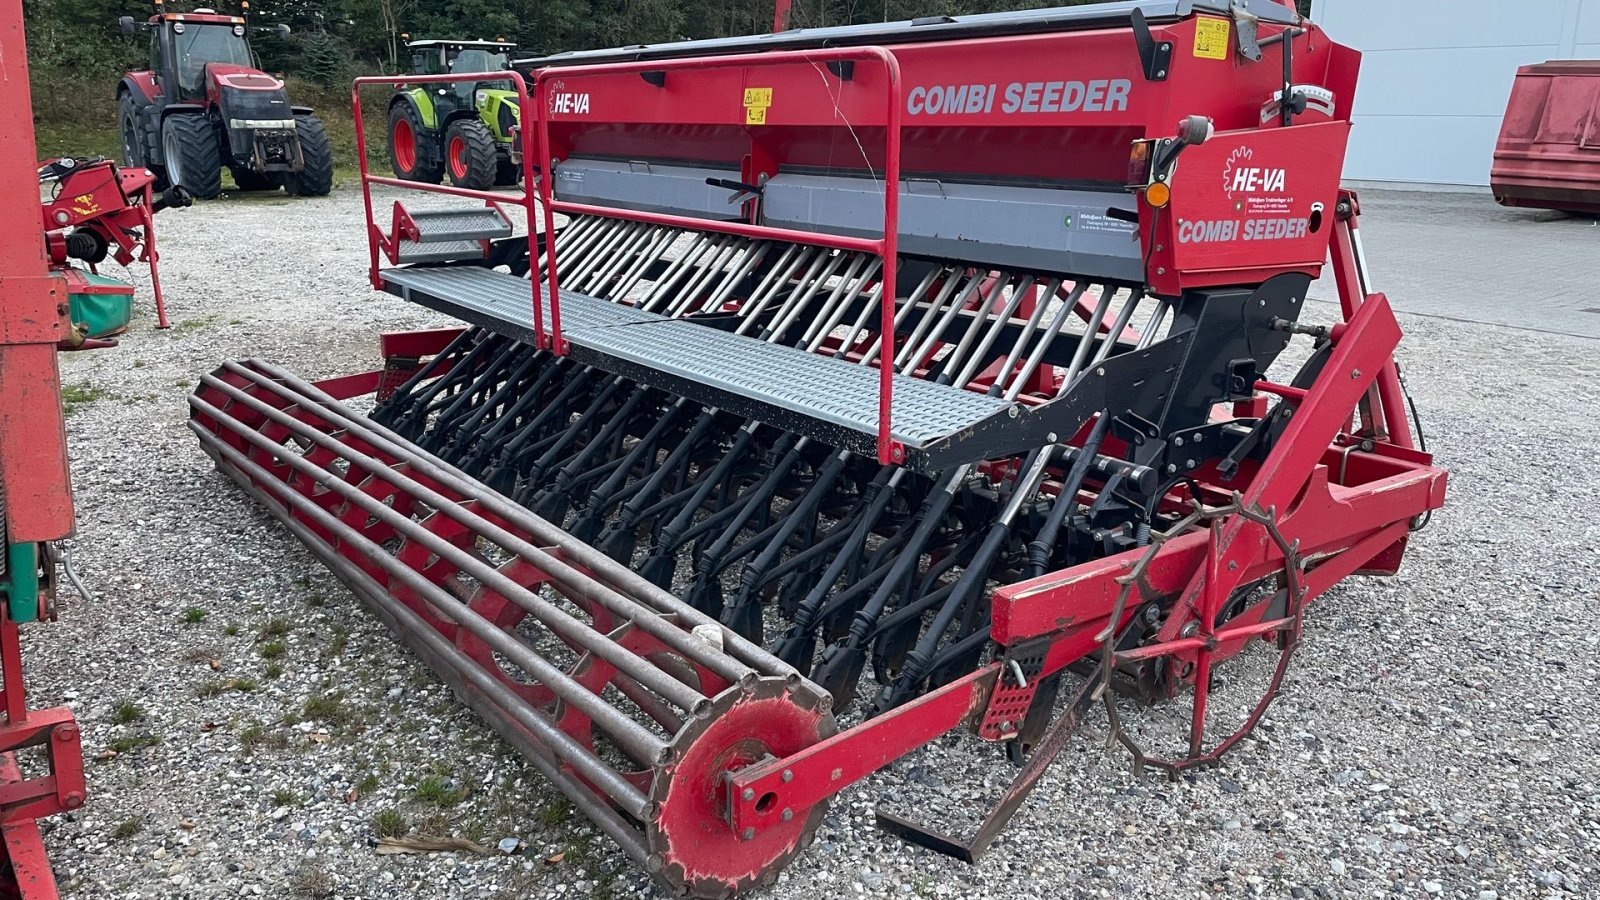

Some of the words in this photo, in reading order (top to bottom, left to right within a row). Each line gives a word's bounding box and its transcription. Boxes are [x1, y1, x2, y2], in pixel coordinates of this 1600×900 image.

[554, 93, 589, 114] HE-VA
[907, 84, 997, 115] COMBI
[1001, 78, 1132, 113] SEEDER
[1231, 167, 1285, 192] HE-VA
[1178, 219, 1240, 244] COMBI
[1242, 217, 1308, 241] SEEDER
